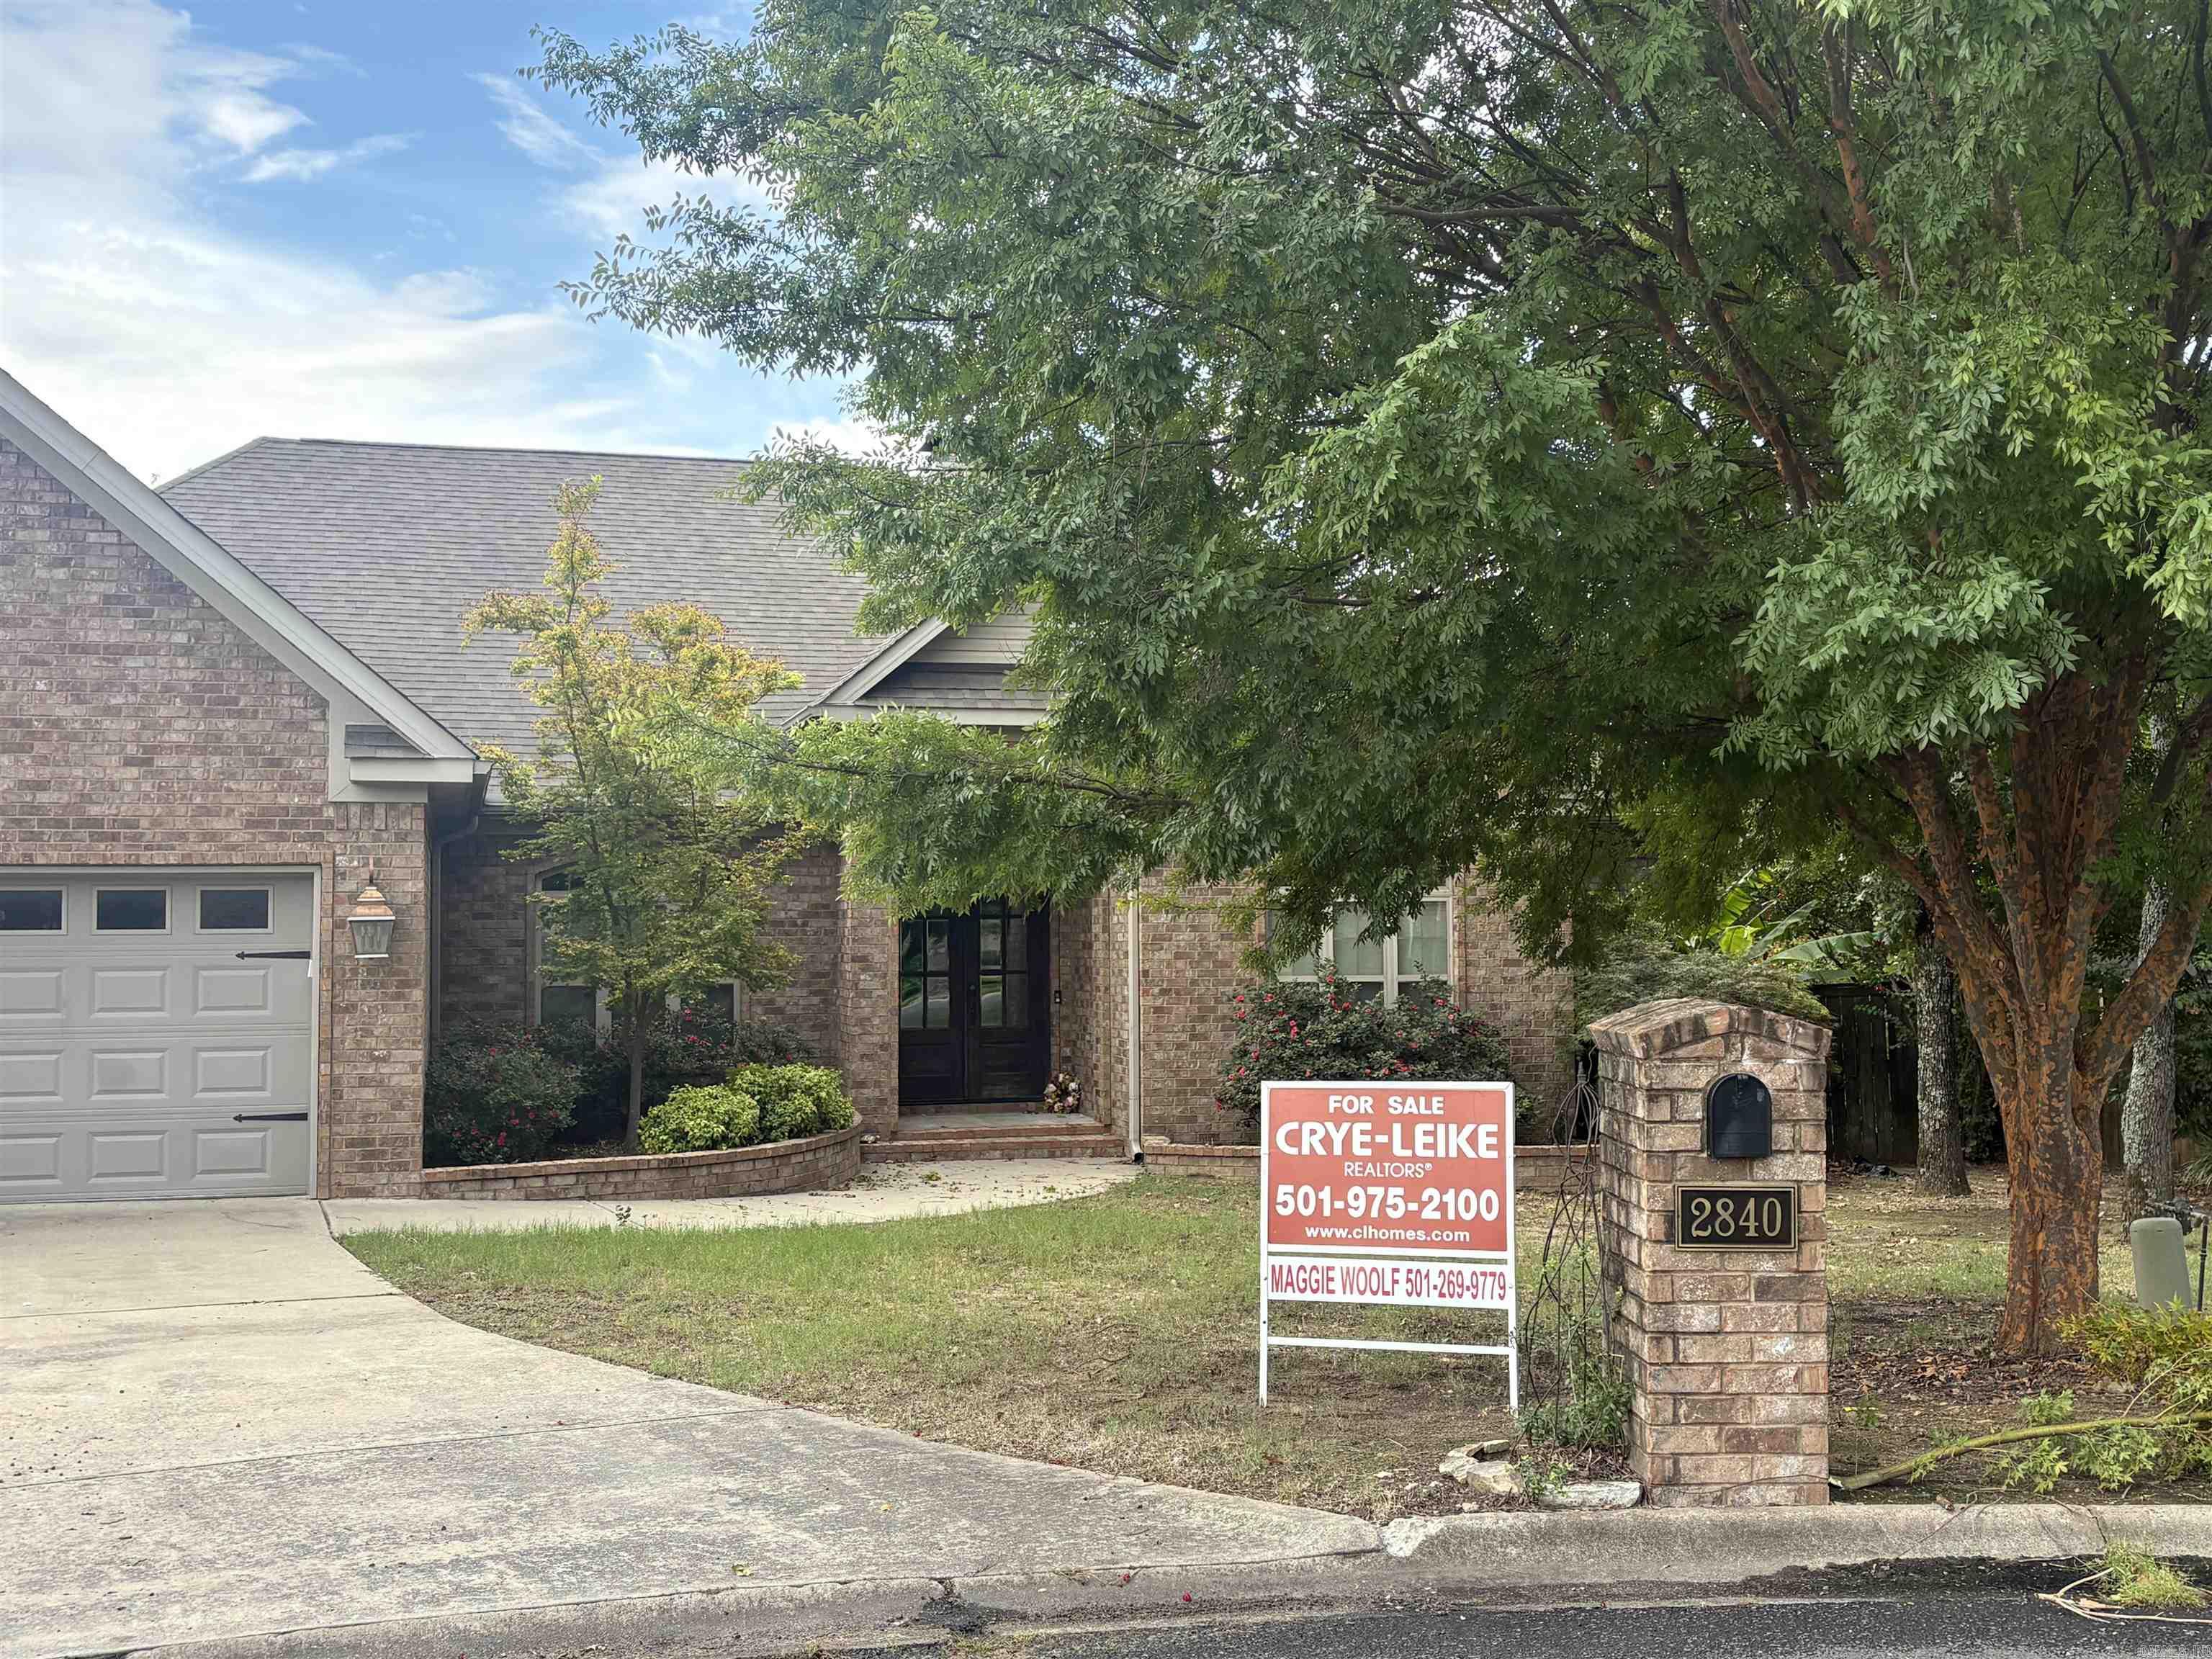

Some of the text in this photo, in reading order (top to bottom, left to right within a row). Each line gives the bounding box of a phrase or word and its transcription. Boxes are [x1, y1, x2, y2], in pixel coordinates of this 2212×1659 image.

[1328, 1094, 1444, 1115] FOR SALE
[1275, 1121, 1498, 1159] CRYE-LEIKE
[1275, 1184, 1499, 1221] 501-975-2100
[1691, 1197, 1782, 1237] 2840
[1305, 1226, 1470, 1242] www.clhomes.com
[1271, 1264, 1506, 1300] MAGGIE WOOLF 501-269-9779
